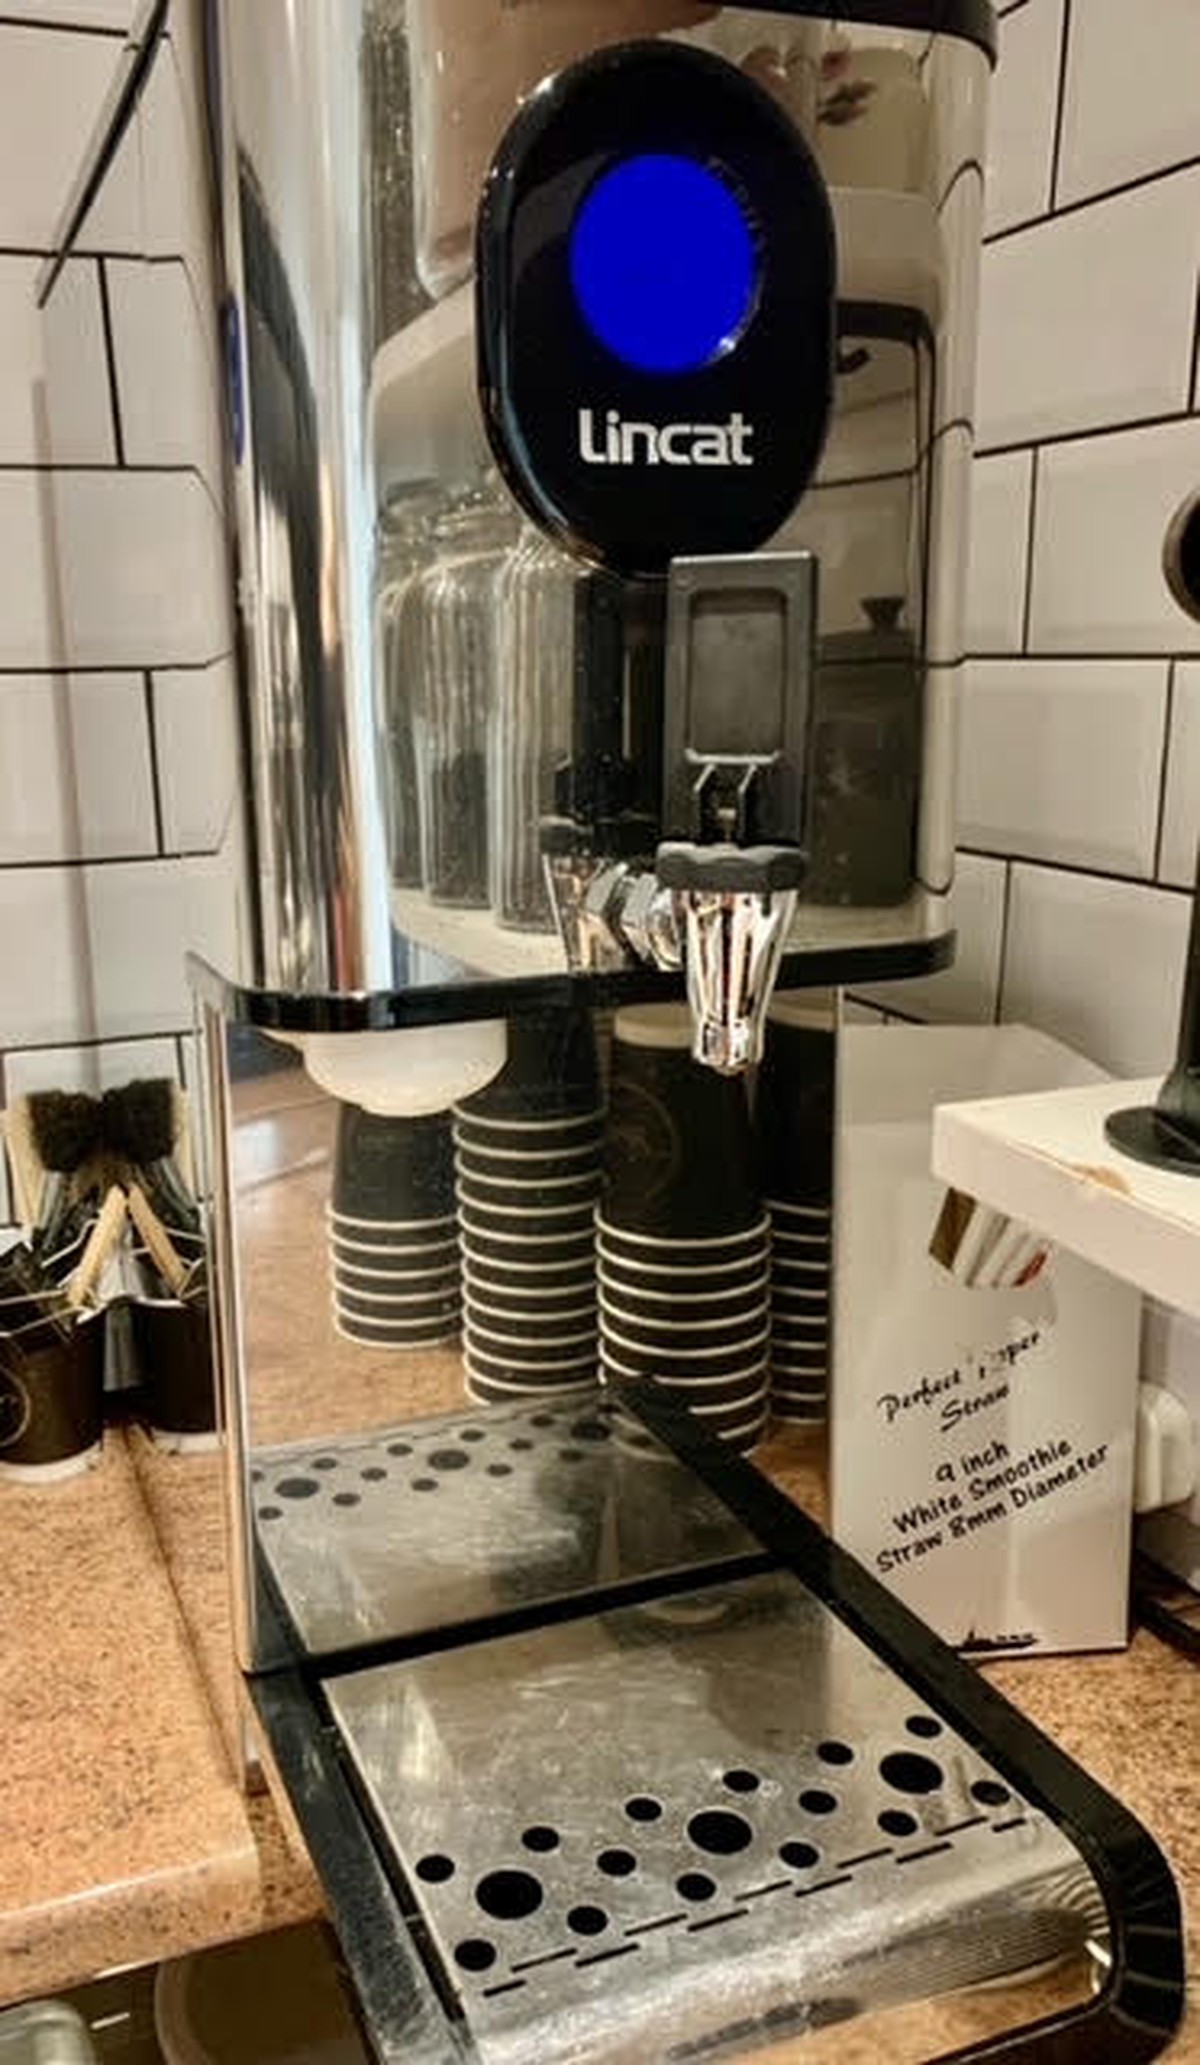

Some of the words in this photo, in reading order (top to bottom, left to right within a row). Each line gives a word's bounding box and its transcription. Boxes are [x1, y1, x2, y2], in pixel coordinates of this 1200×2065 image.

[579, 408, 753, 465] Lincat
[941, 1383, 1009, 1433] Straw
[960, 1440, 1010, 1476] inch
[876, 1531, 943, 1573] Straw
[948, 1501, 1008, 1539] 8mm
[1009, 1444, 1108, 1509] Diameter
[892, 1494, 963, 1535] White
[968, 1439, 1072, 1501] Smoothie
